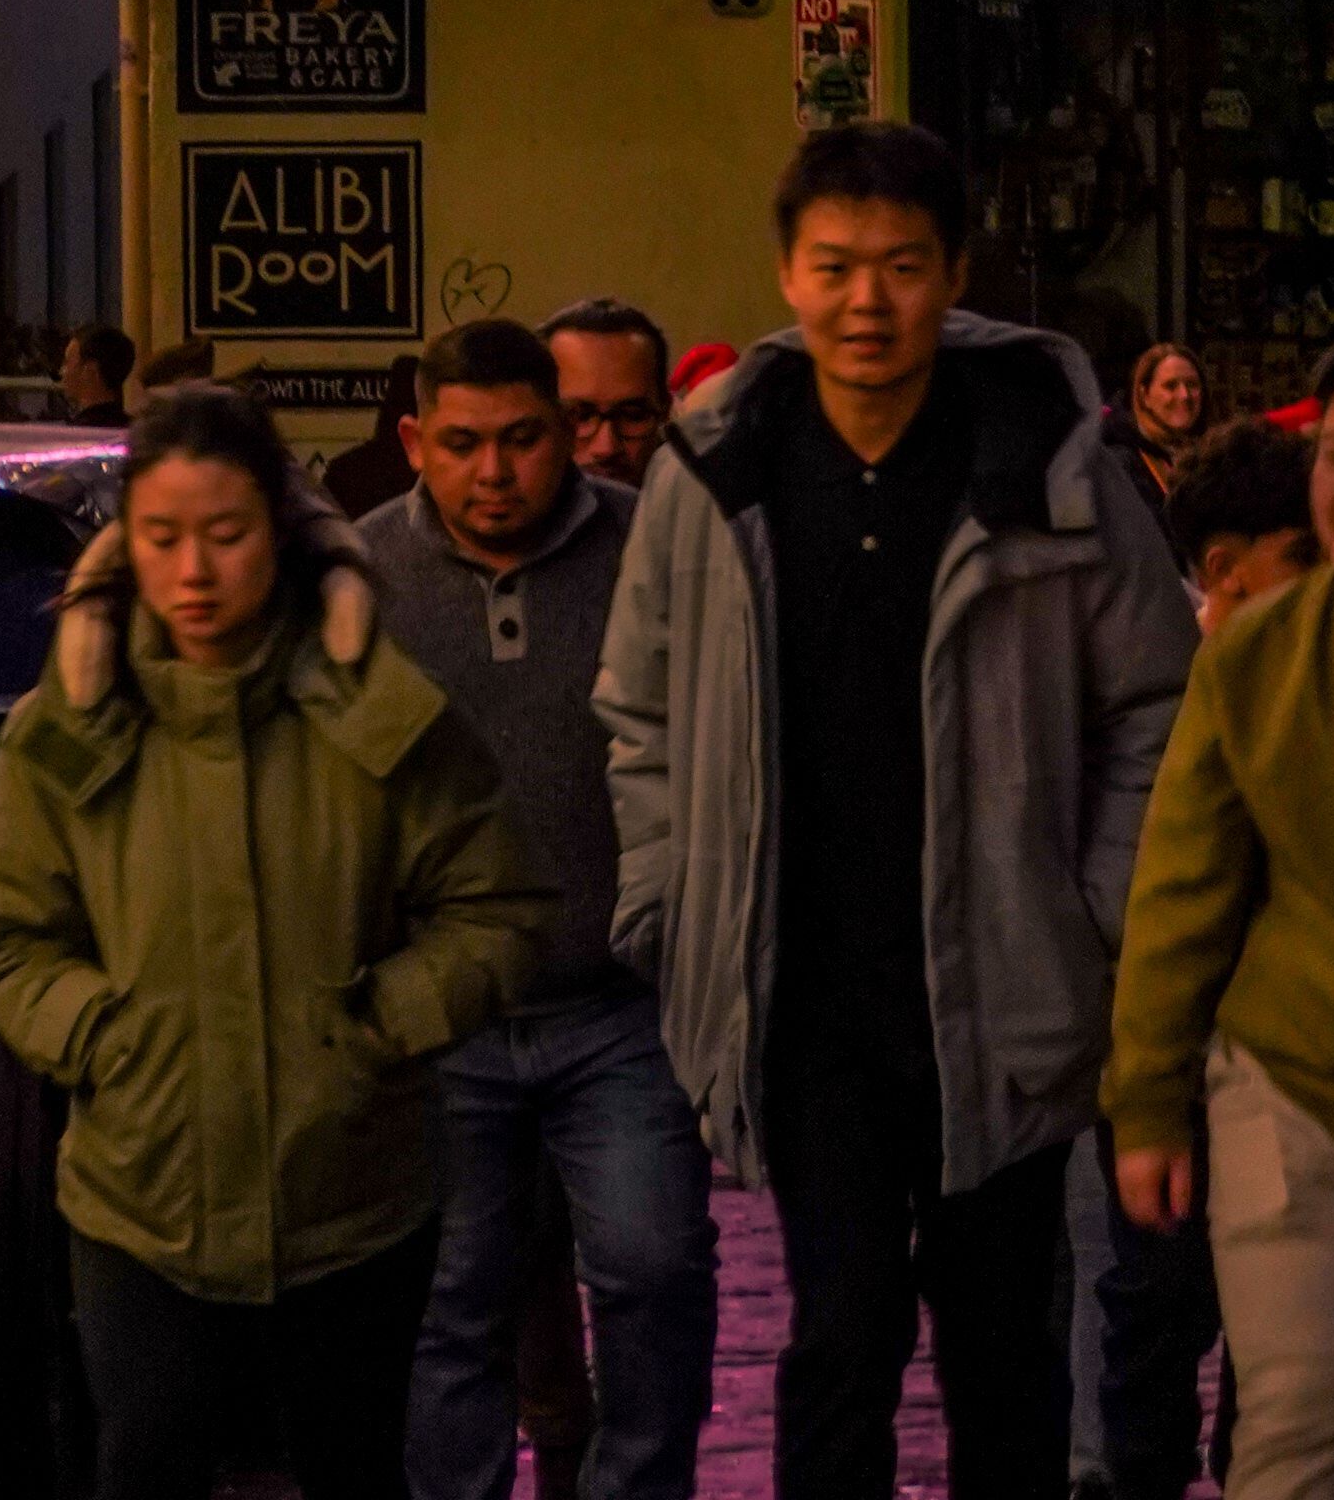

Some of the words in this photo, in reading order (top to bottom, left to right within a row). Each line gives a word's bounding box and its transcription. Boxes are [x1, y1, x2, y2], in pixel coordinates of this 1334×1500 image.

[210, 9, 399, 45] FREYA
[284, 47, 398, 67] BAKERY
[219, 158, 393, 235] ALIBI
